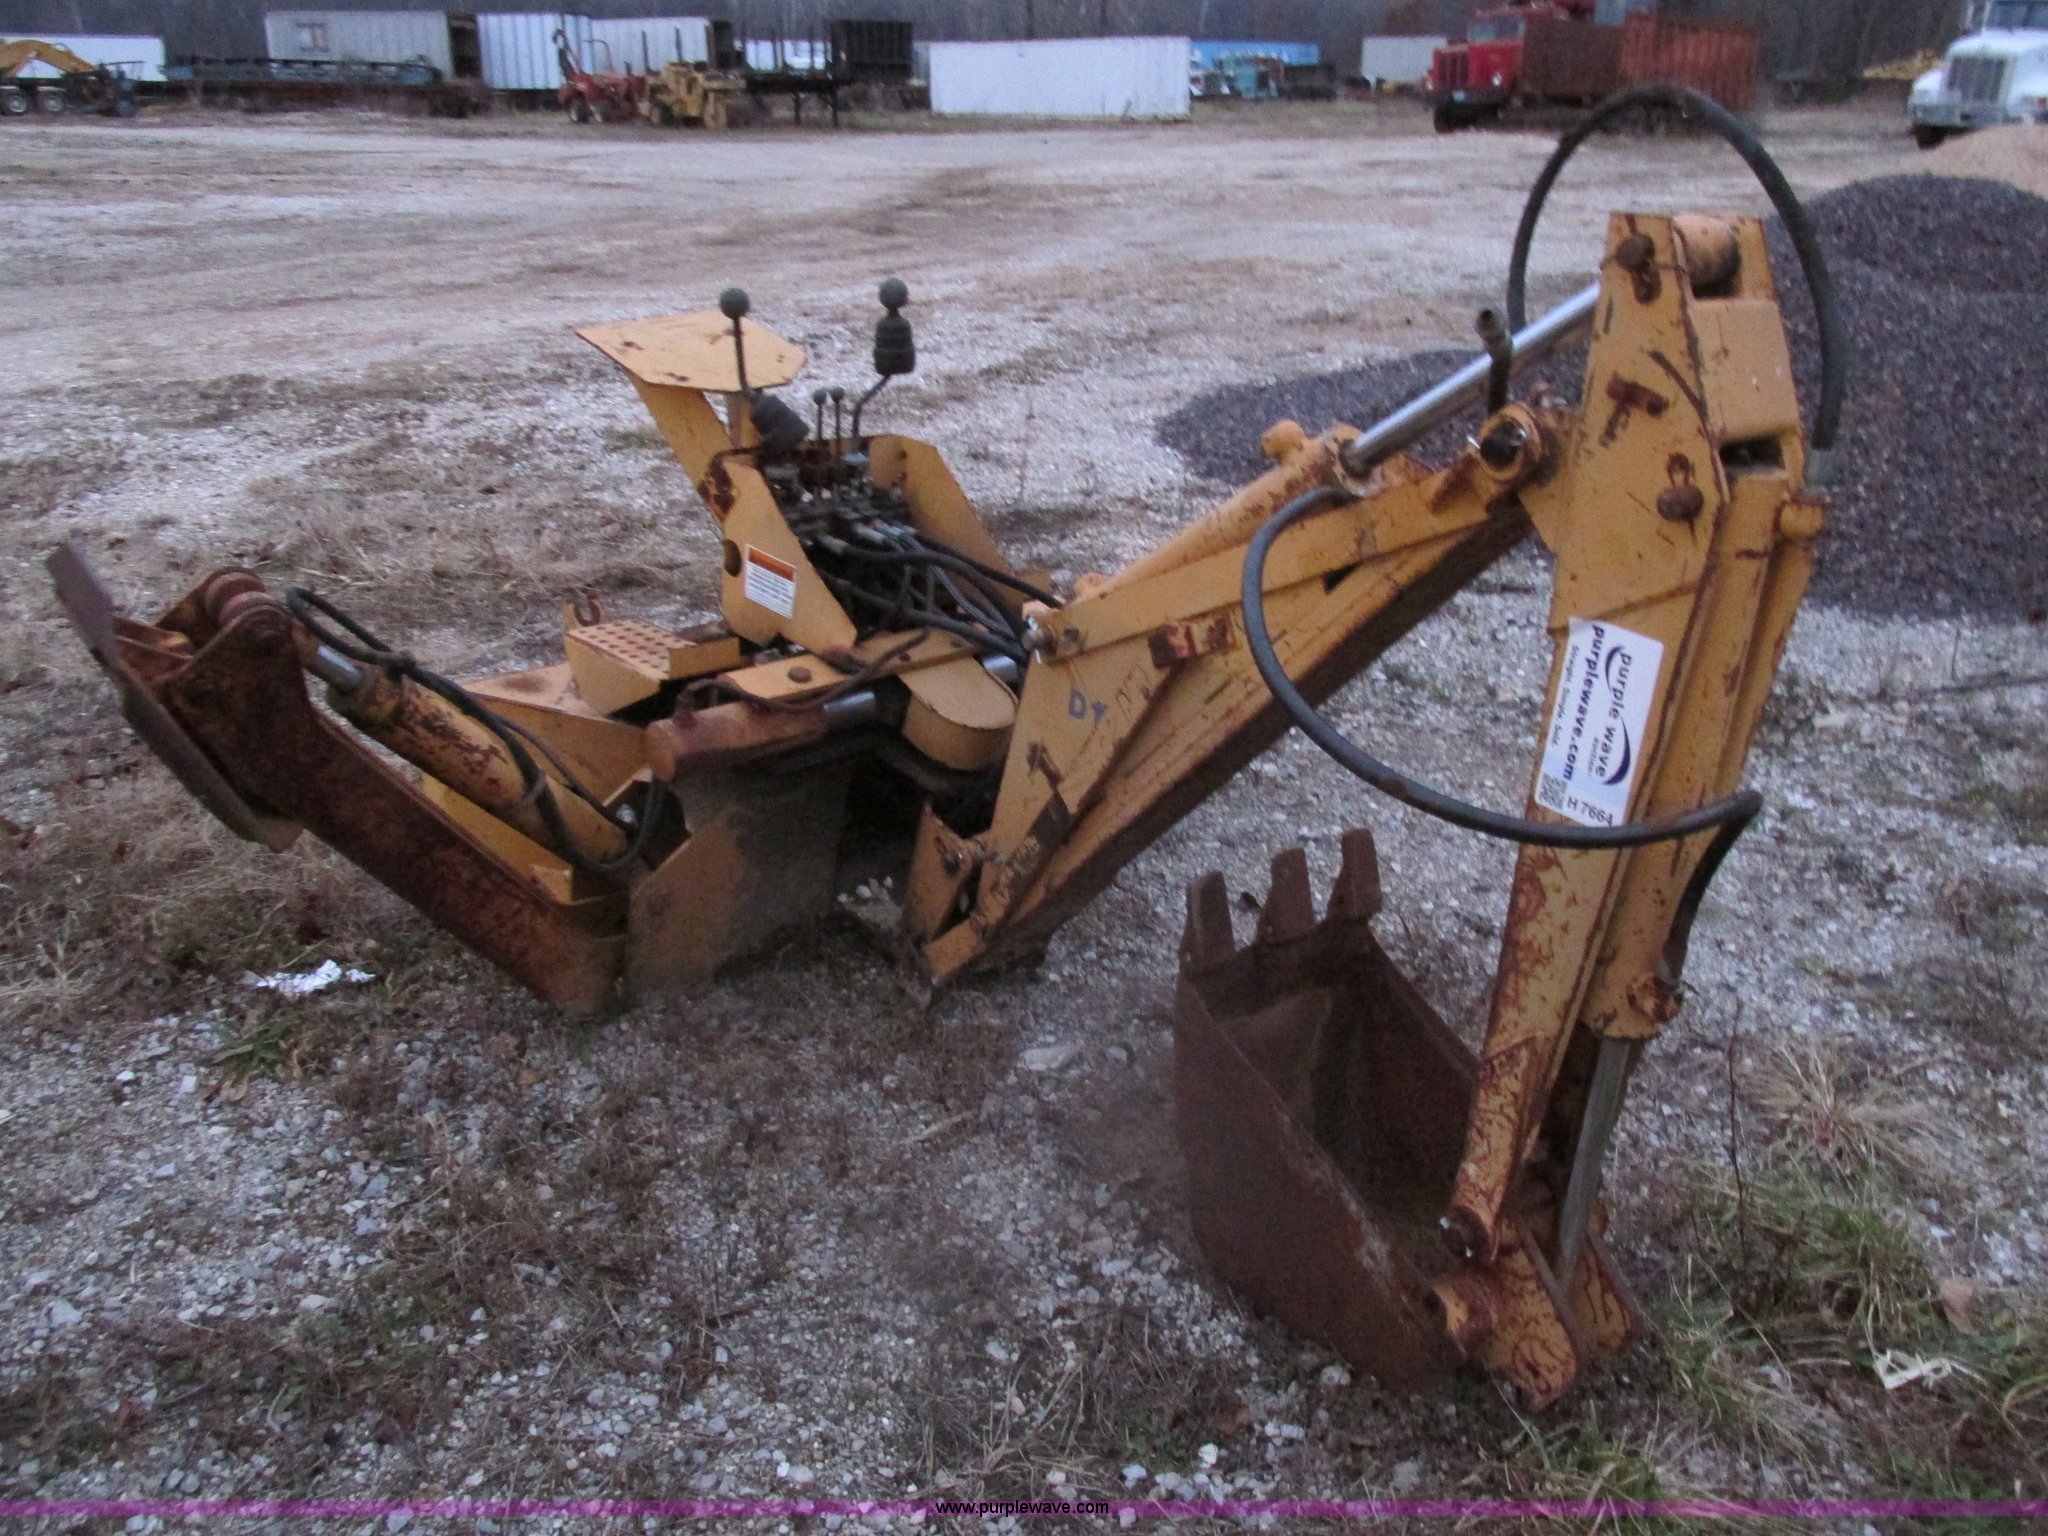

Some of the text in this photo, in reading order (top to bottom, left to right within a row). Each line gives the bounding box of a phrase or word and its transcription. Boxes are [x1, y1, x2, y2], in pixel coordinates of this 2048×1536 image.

[1563, 624, 1605, 780] purplewave.com
[1595, 653, 1632, 777] purple wave
